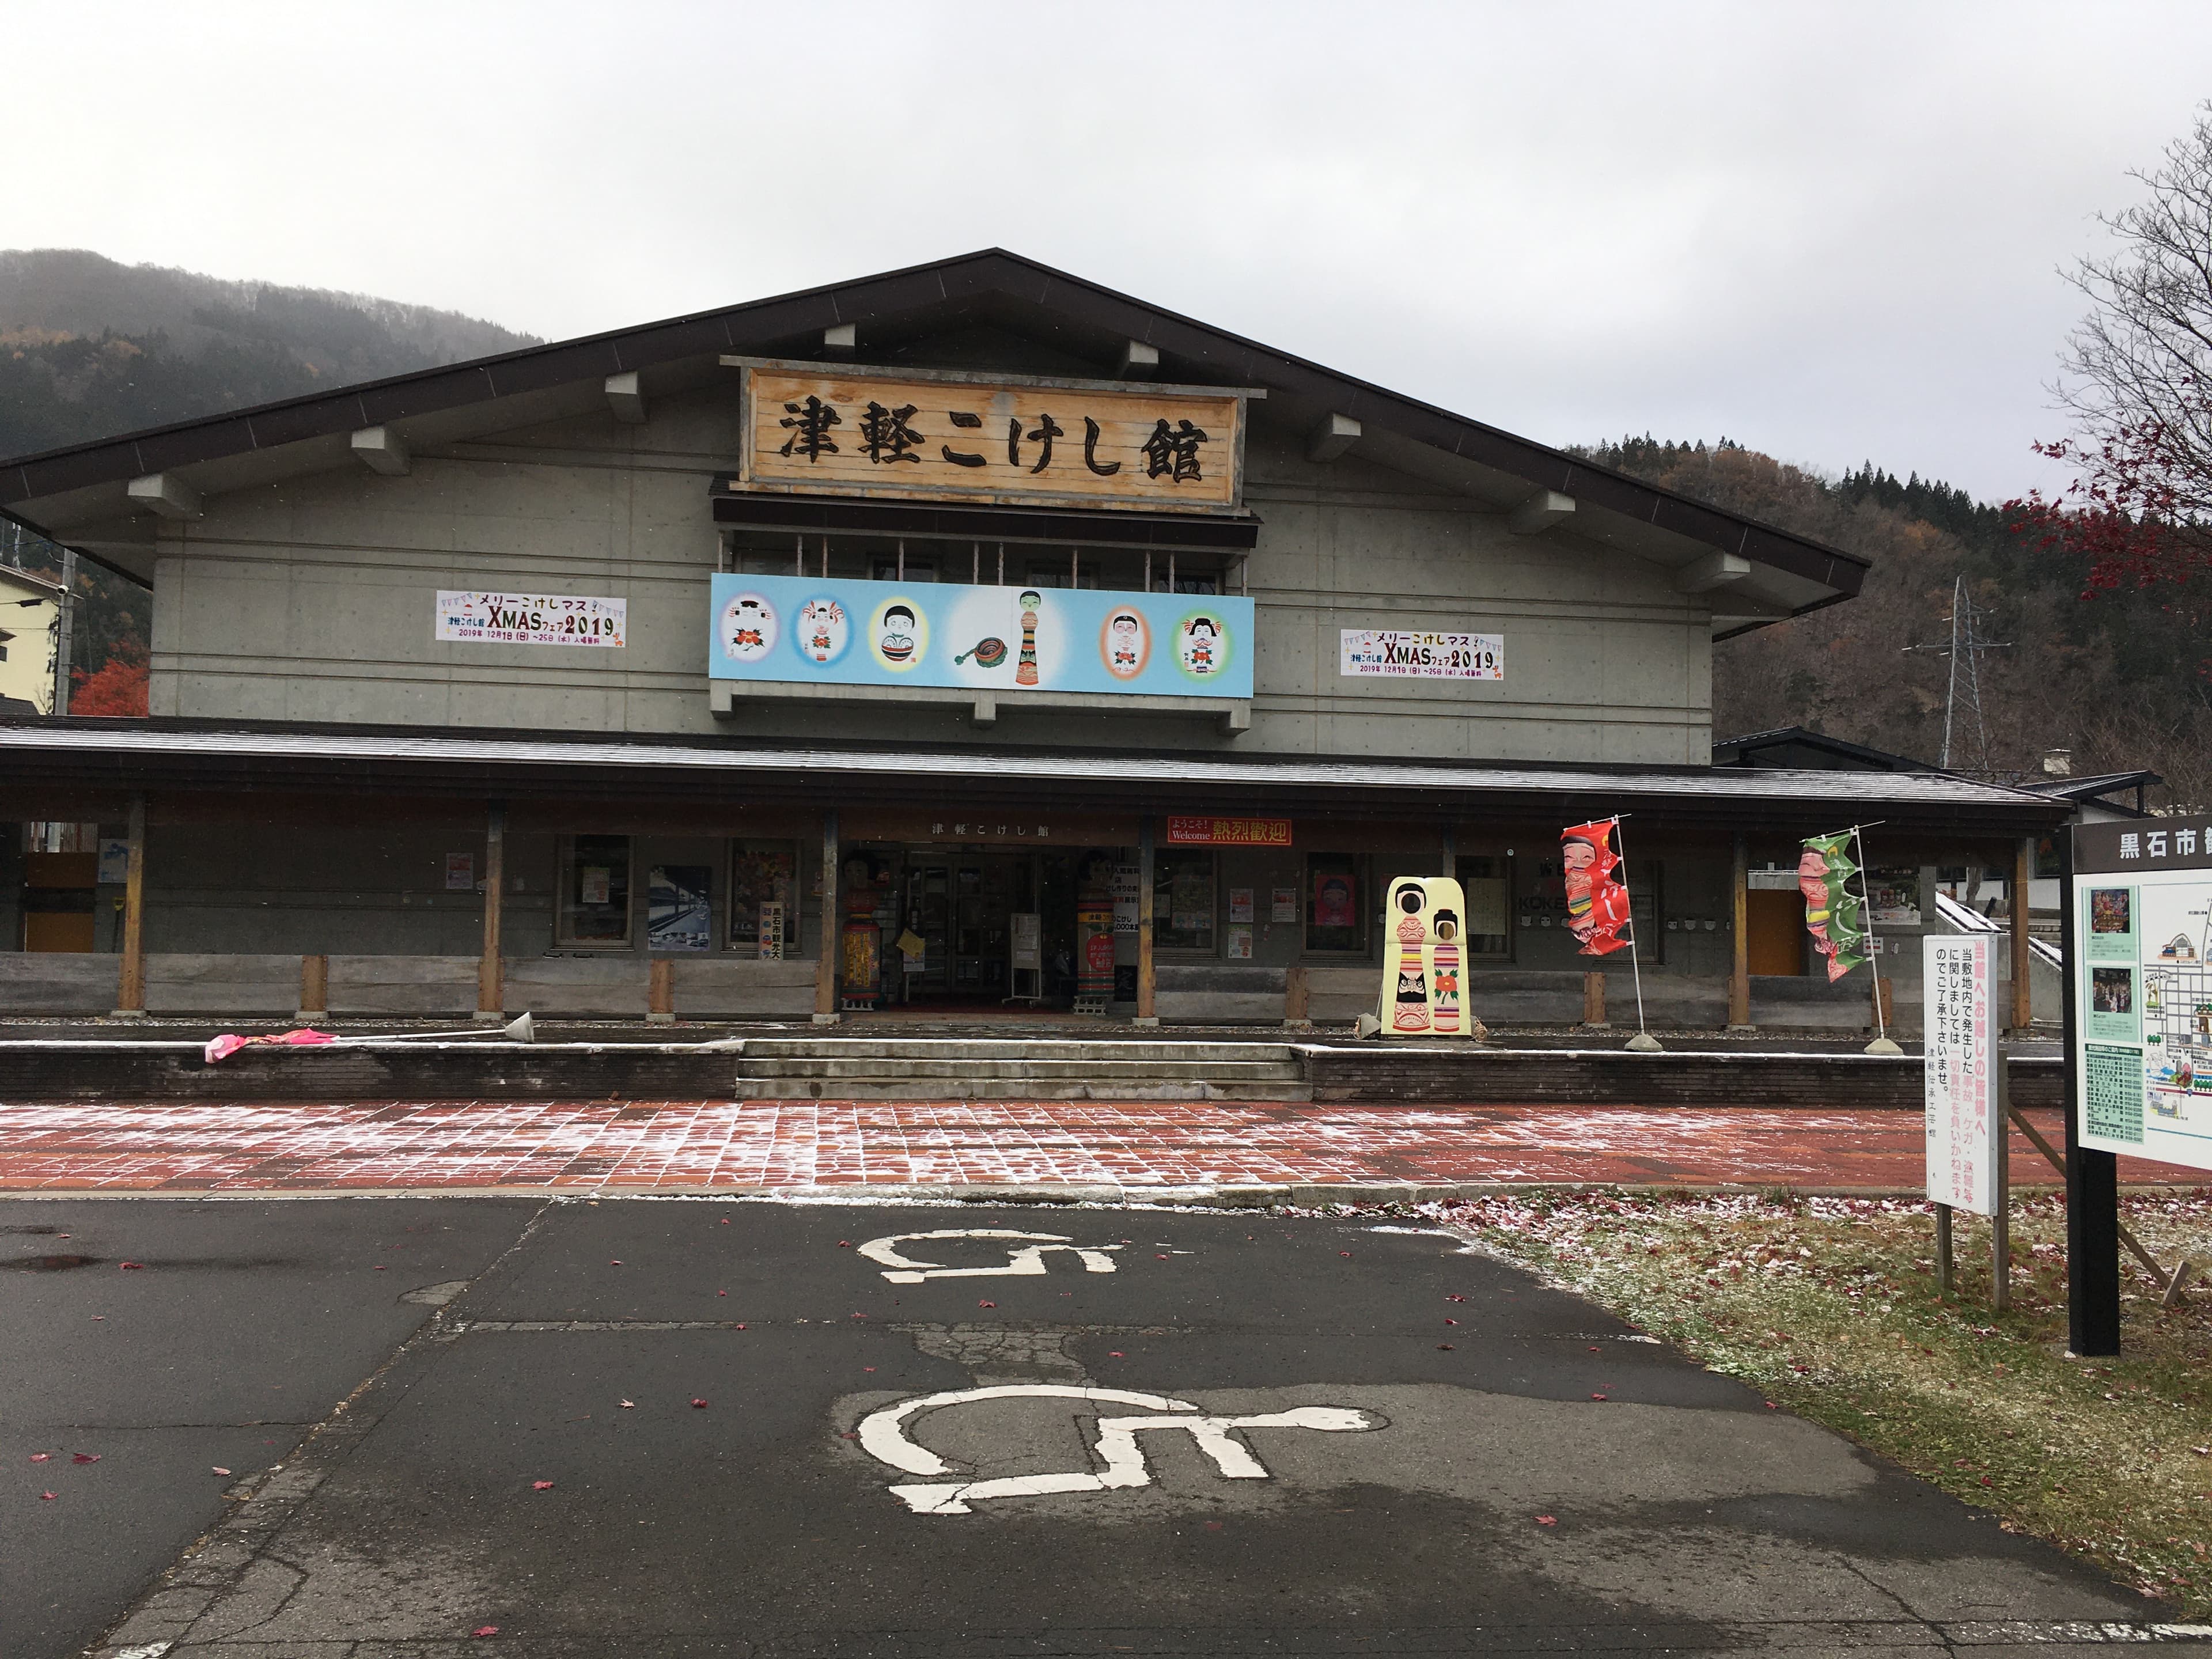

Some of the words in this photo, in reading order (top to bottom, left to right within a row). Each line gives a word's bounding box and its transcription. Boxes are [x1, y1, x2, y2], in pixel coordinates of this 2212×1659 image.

[779, 395, 1208, 484] 津軽こけし館
[932, 823, 1049, 837] 津軽こけし館
[1172, 830, 1210, 840] Welcome
